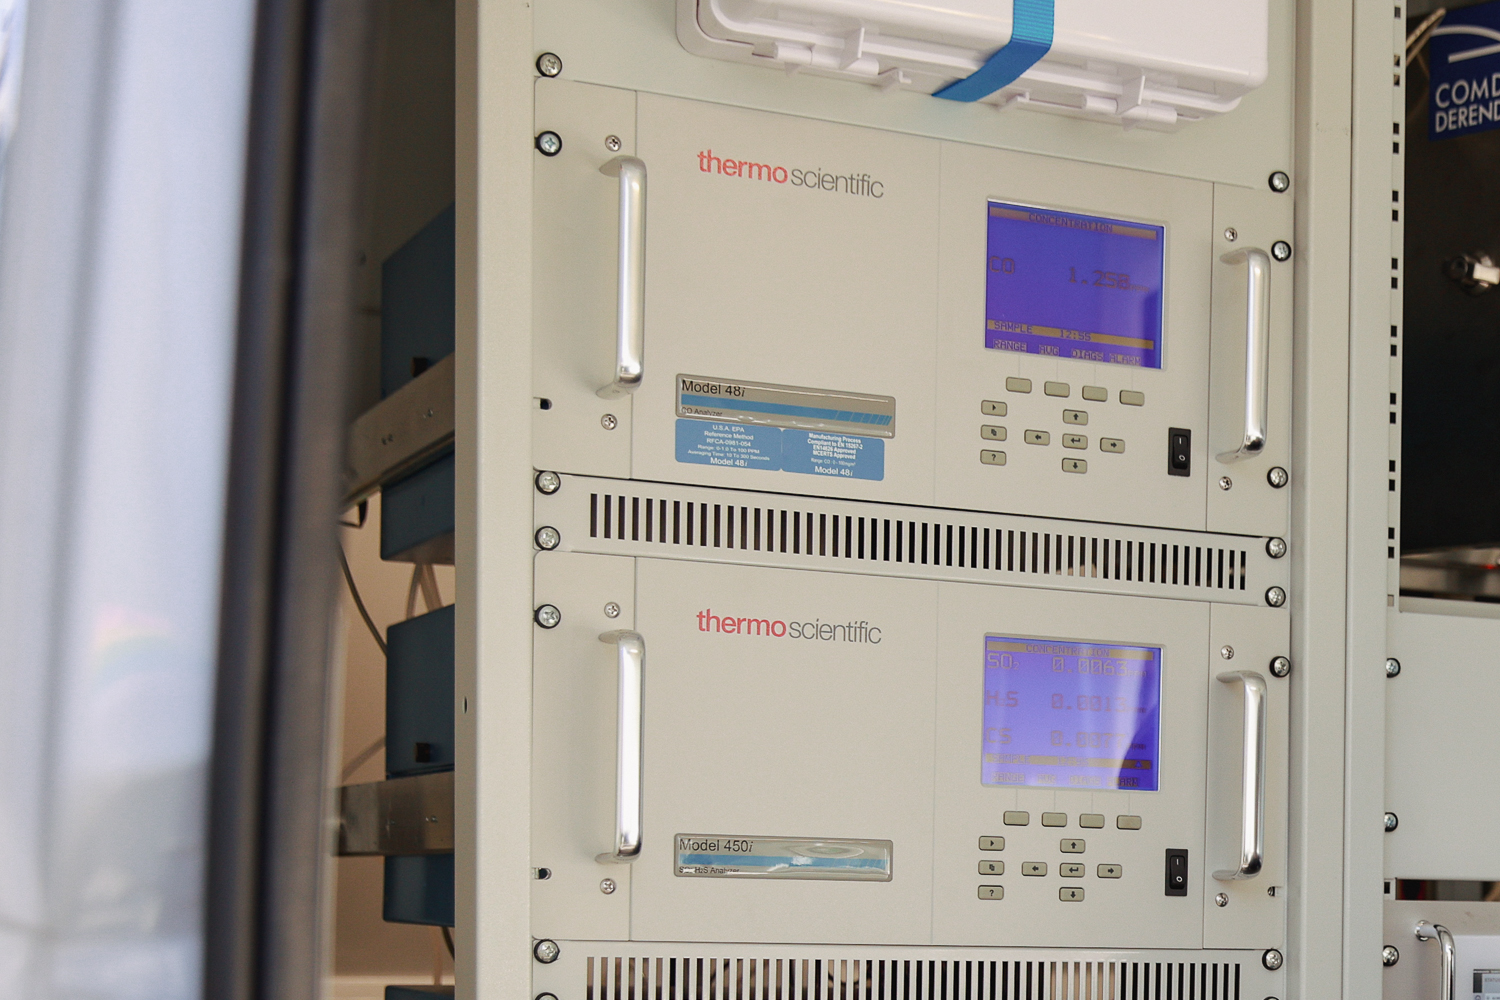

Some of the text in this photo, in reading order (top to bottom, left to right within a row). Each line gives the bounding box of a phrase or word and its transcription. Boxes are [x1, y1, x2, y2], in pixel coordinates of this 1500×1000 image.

[698, 149, 884, 198] thermo scientific
[1029, 214, 1113, 232] CONCENTRATION
[989, 256, 1015, 274] CO
[994, 322, 1091, 341] SAMPLE 12:55
[994, 339, 1027, 352] RANGE
[1071, 348, 1103, 362] DIAGS
[1109, 353, 1141, 366] ALARM
[682, 379, 745, 397] Model 48i
[694, 408, 722, 417] Analyzer
[809, 433, 841, 442] Manufacturing
[710, 457, 733, 465] Model
[815, 466, 838, 474] Model
[697, 609, 881, 644] thermo scientific
[1026, 644, 1110, 657] CONCENTRATION
[992, 754, 1030, 764] SAMPLE
[680, 839, 753, 852] Model 450i
